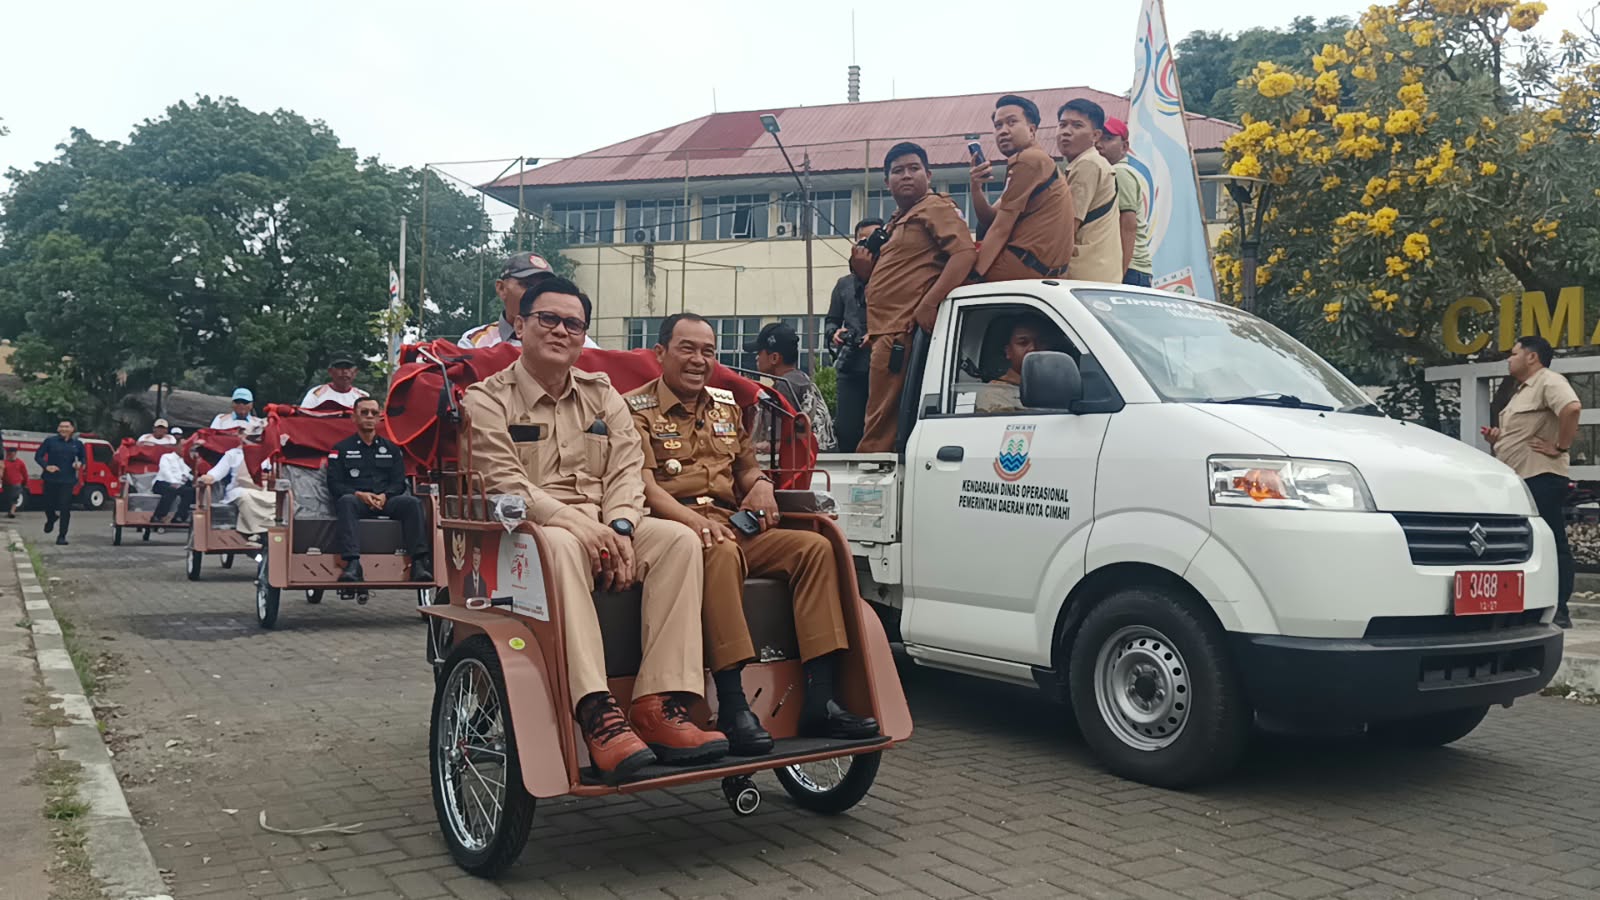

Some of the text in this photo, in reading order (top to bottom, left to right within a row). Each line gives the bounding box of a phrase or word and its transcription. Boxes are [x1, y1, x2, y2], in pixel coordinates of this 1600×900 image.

[1109, 296, 1183, 309] CIMAHI
[961, 480, 1069, 503] KENDARAAN DINAS OPERASIONAL
[959, 495, 1070, 520] PEMERINTAH DAERAH KOTA CIMAHI
[1470, 573, 1498, 598] 3488
[1517, 573, 1523, 597] T
